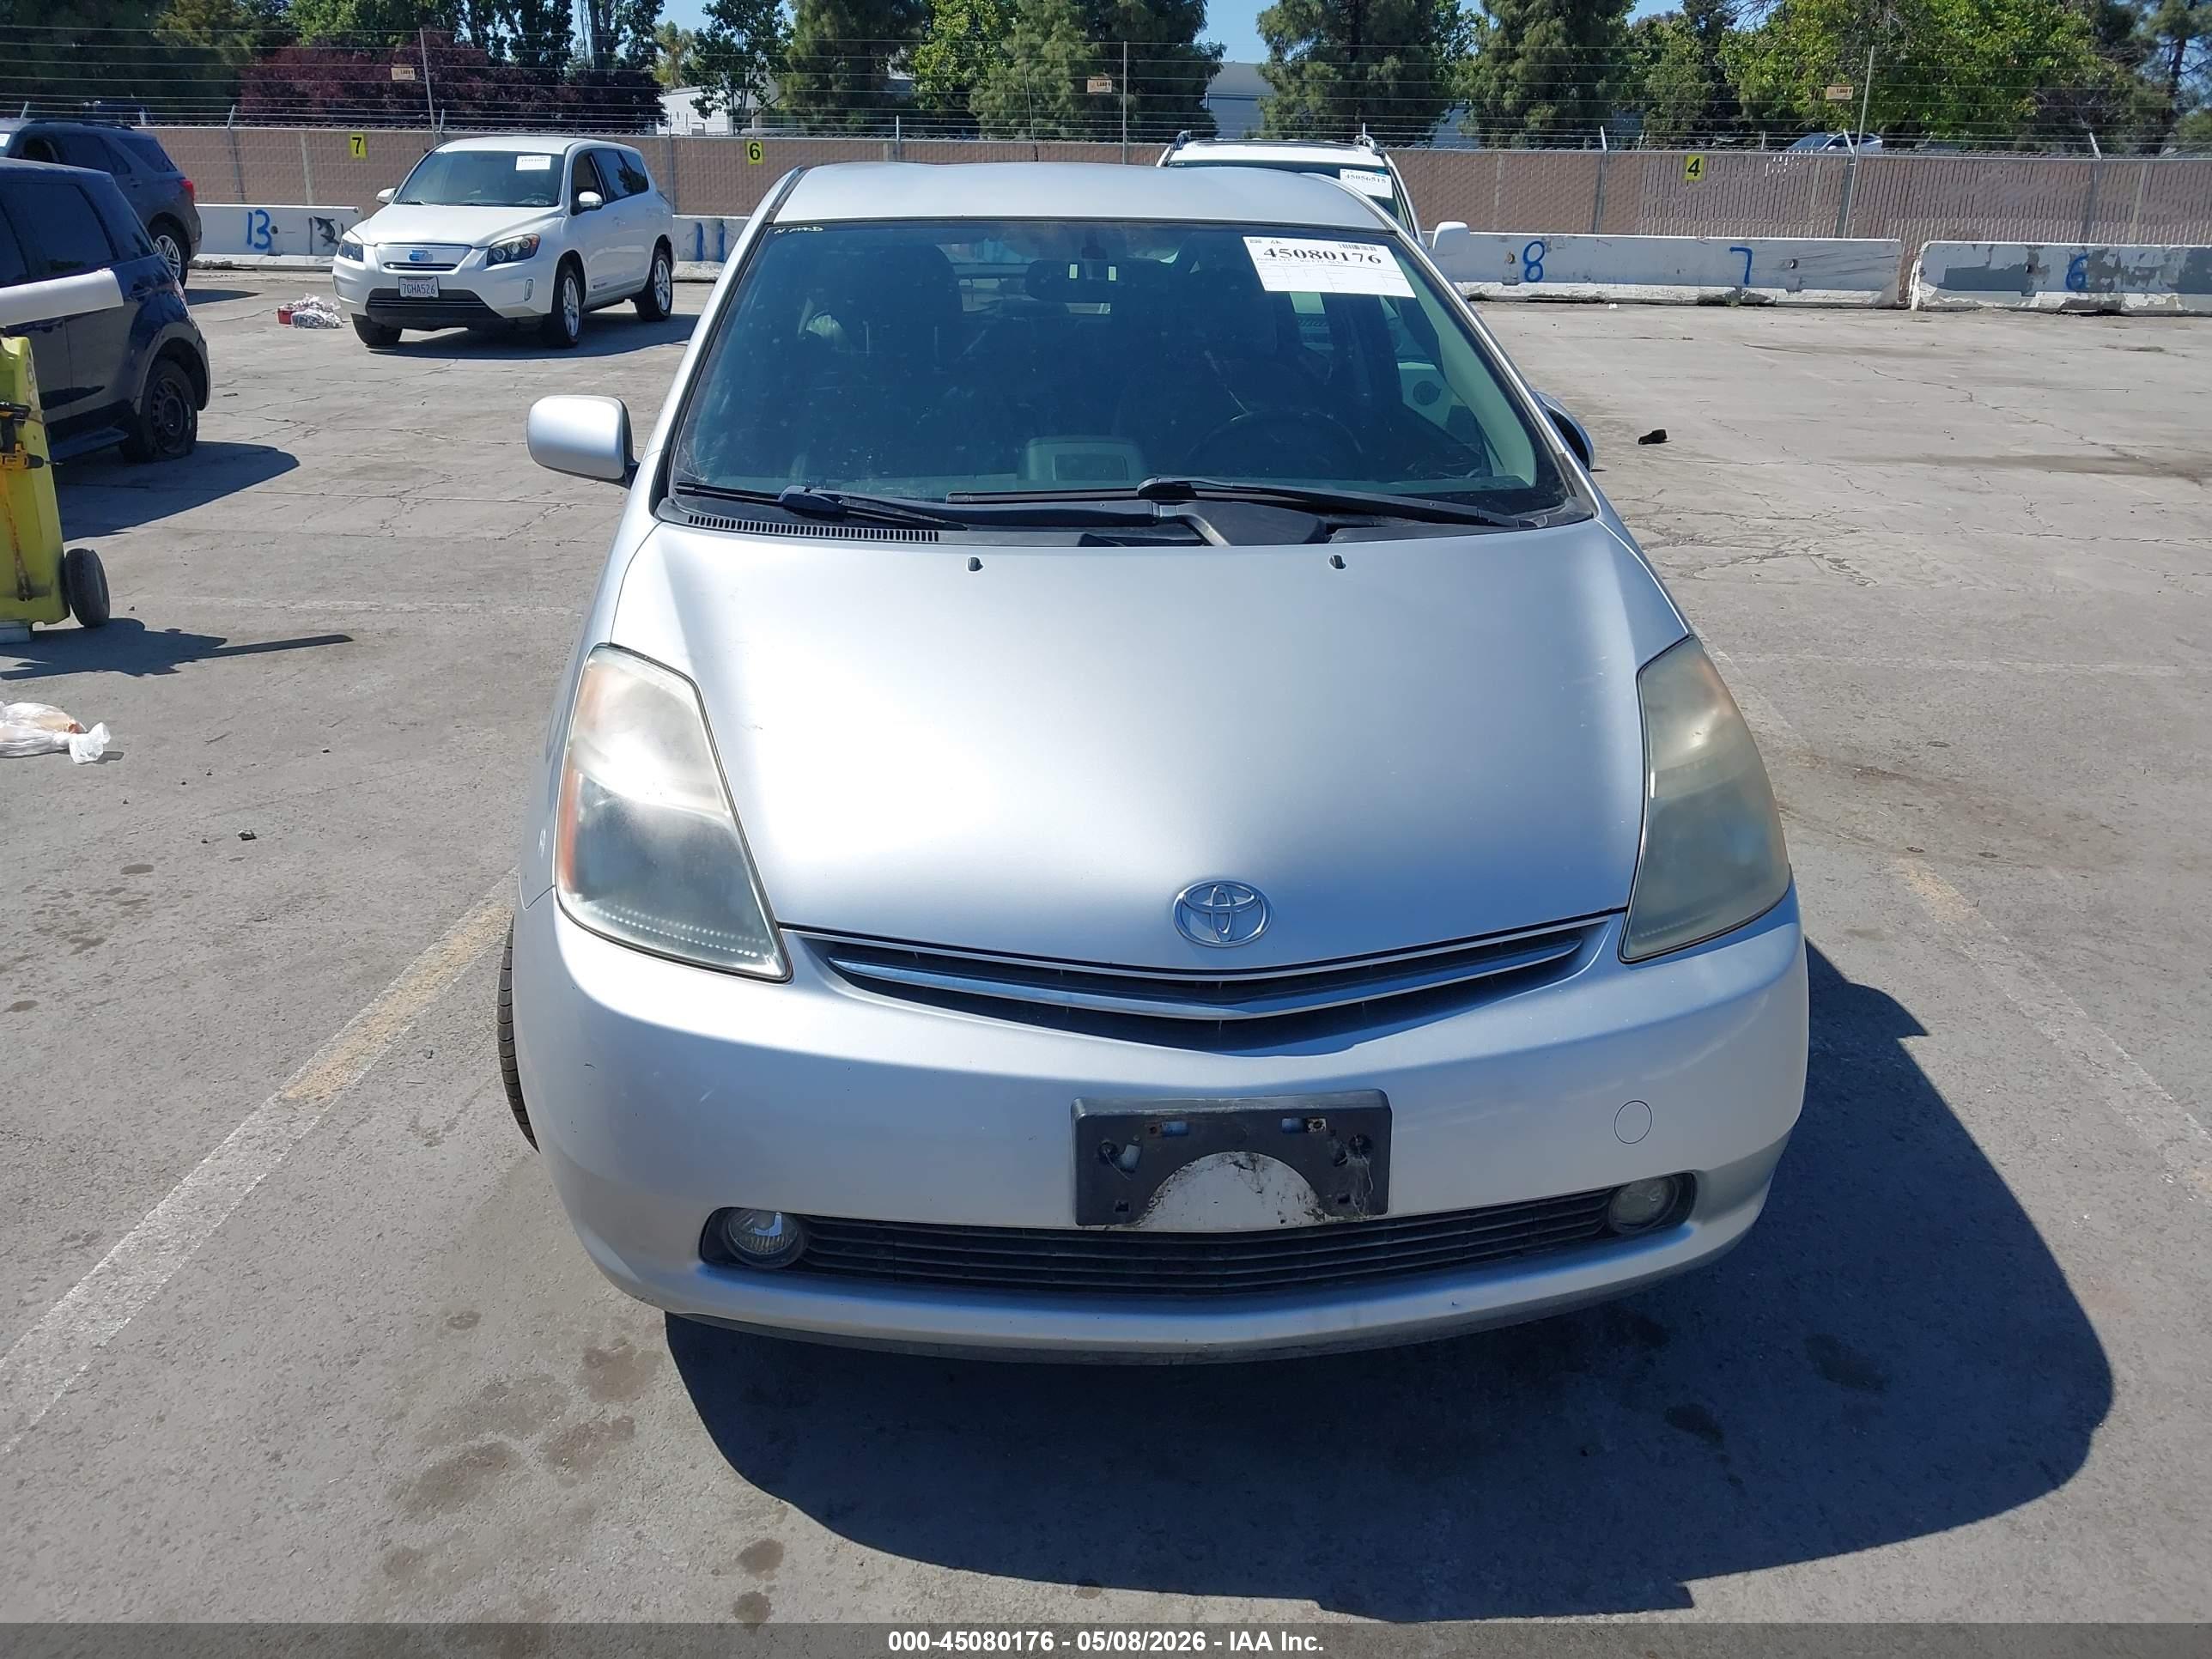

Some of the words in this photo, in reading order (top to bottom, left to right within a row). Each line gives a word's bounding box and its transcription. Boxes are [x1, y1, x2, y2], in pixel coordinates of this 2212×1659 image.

[352, 137, 362, 155] 7
[749, 142, 761, 161] 6
[1687, 157, 1701, 177] 4
[246, 209, 272, 250] 13
[1263, 247, 1382, 264] 45080176
[1523, 240, 1546, 283] 8
[1729, 246, 1753, 287] 7
[2065, 253, 2089, 291] 6
[401, 283, 435, 295] 7GHA526
